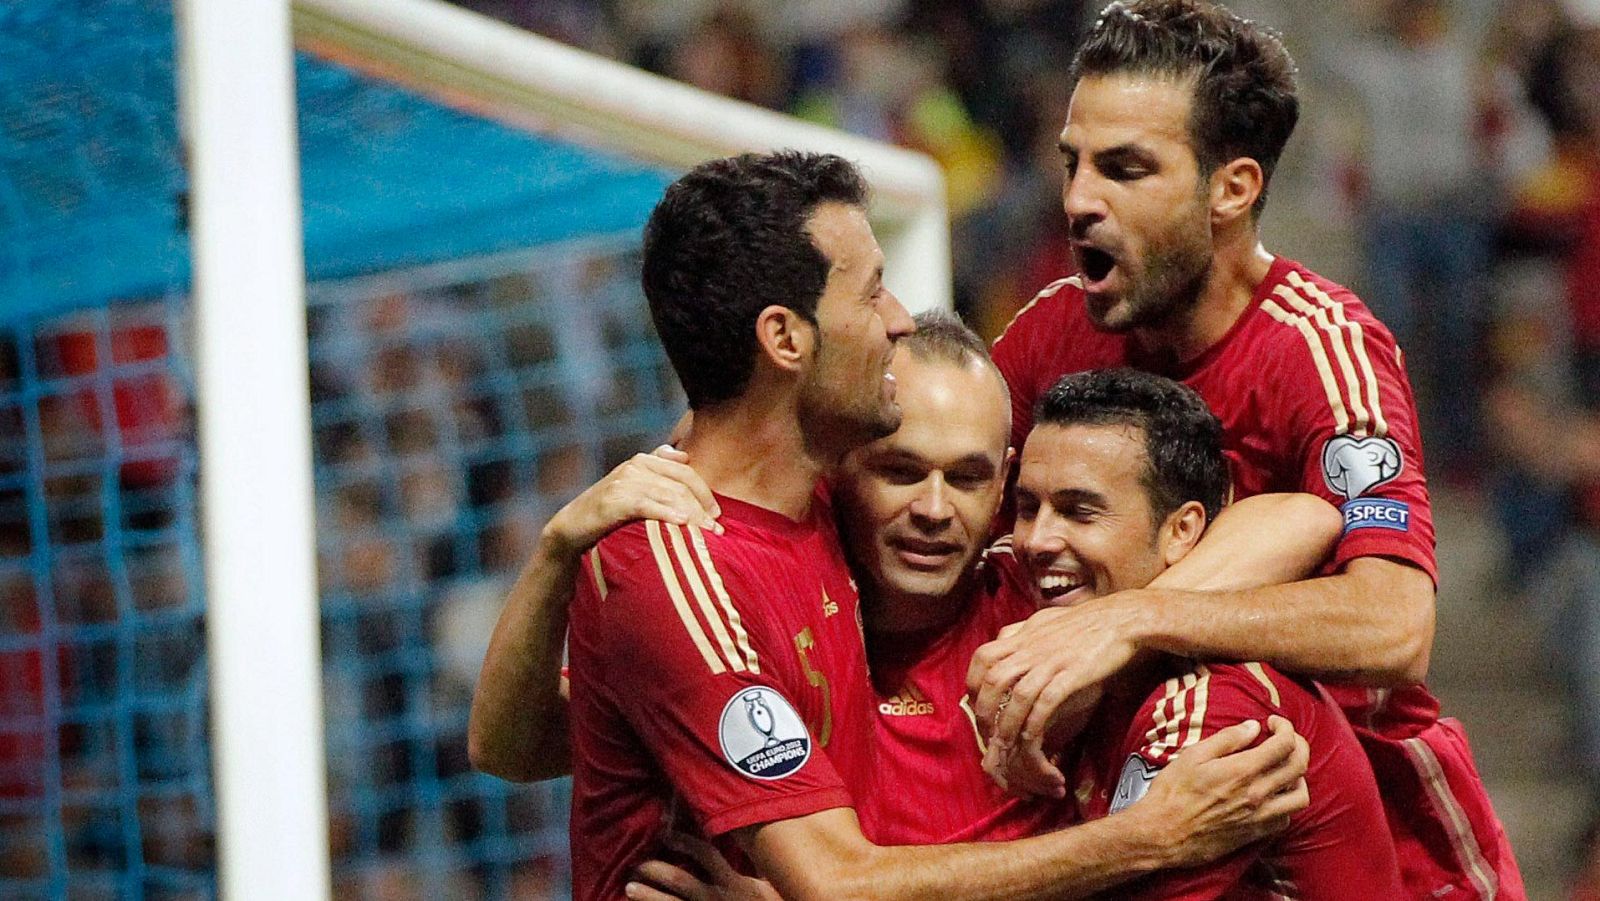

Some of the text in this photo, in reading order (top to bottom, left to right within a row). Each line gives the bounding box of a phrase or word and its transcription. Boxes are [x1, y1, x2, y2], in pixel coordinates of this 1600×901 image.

[1345, 505, 1408, 523] ESPECT
[879, 701, 934, 716] adidas
[746, 752, 766, 764] UEFA
[765, 745, 785, 757] EURO
[749, 746, 806, 773] CHAMPIONS
